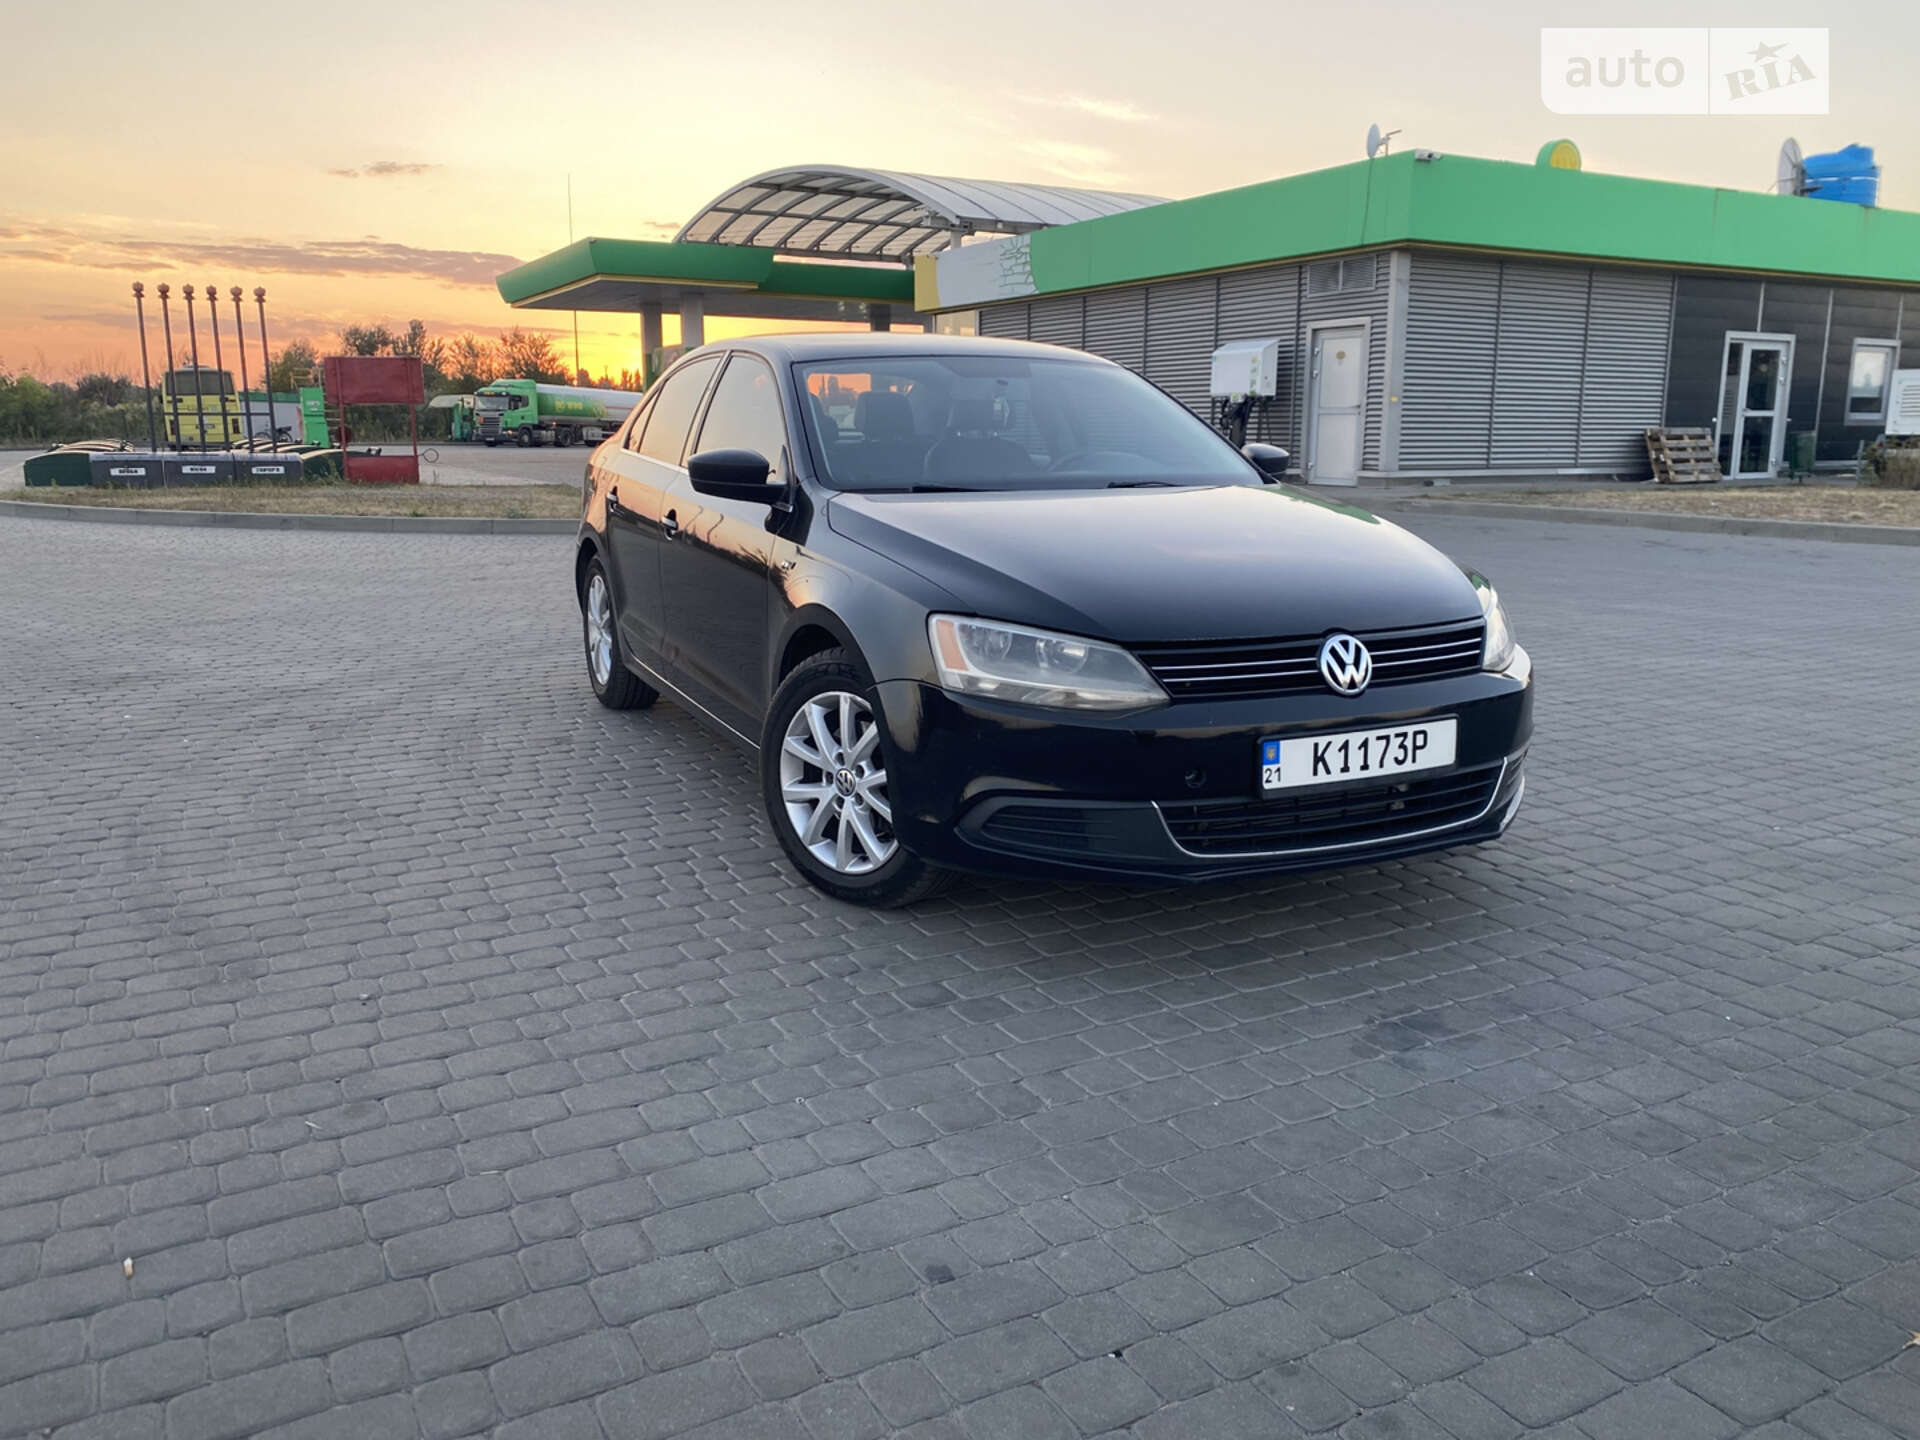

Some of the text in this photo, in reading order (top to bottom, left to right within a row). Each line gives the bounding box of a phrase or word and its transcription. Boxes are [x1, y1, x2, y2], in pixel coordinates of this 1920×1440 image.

[1321, 634, 1372, 695] VW
[1264, 767, 1281, 784] 21
[1312, 729, 1428, 777] K1173P
